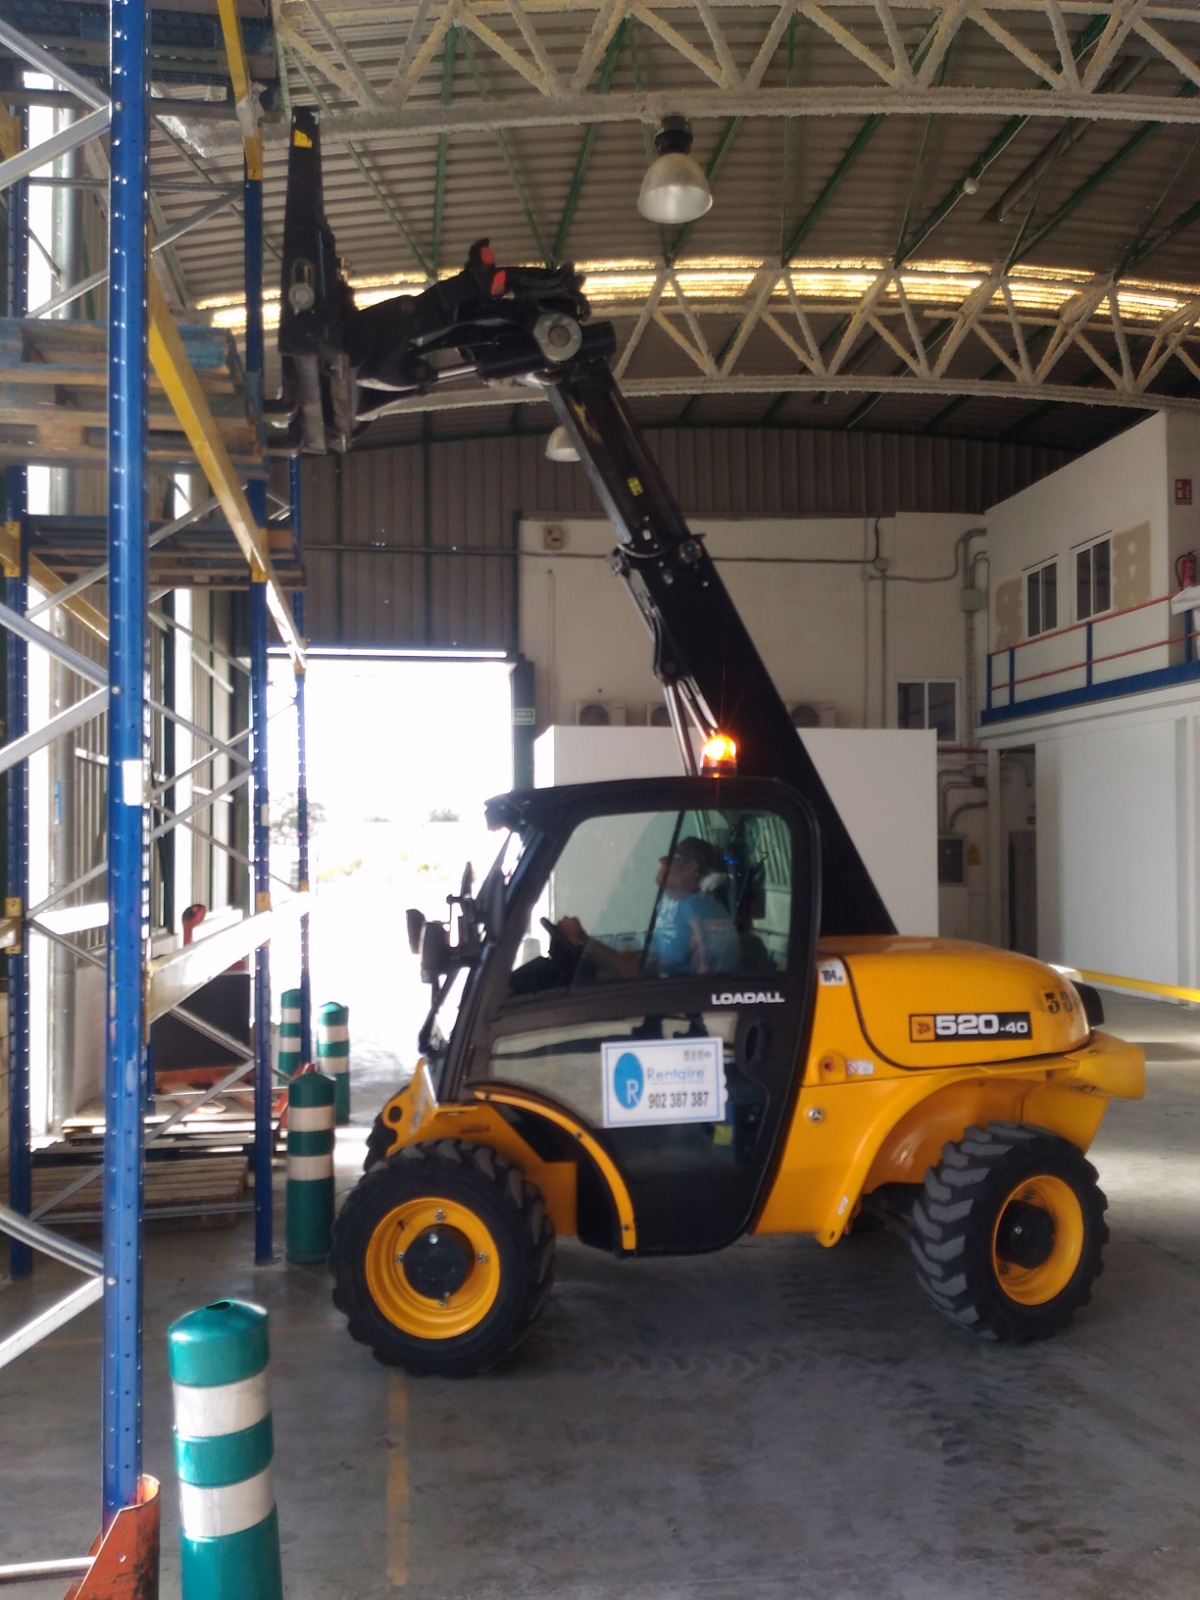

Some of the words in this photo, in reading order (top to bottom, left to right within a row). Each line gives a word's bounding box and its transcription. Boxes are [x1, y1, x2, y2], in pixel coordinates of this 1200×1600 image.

[711, 992, 786, 1006] LOADALL
[647, 1067, 705, 1081] Rentaire
[648, 1093, 667, 1109] 902
[670, 1092, 689, 1108] 387
[691, 1091, 710, 1108] 387
